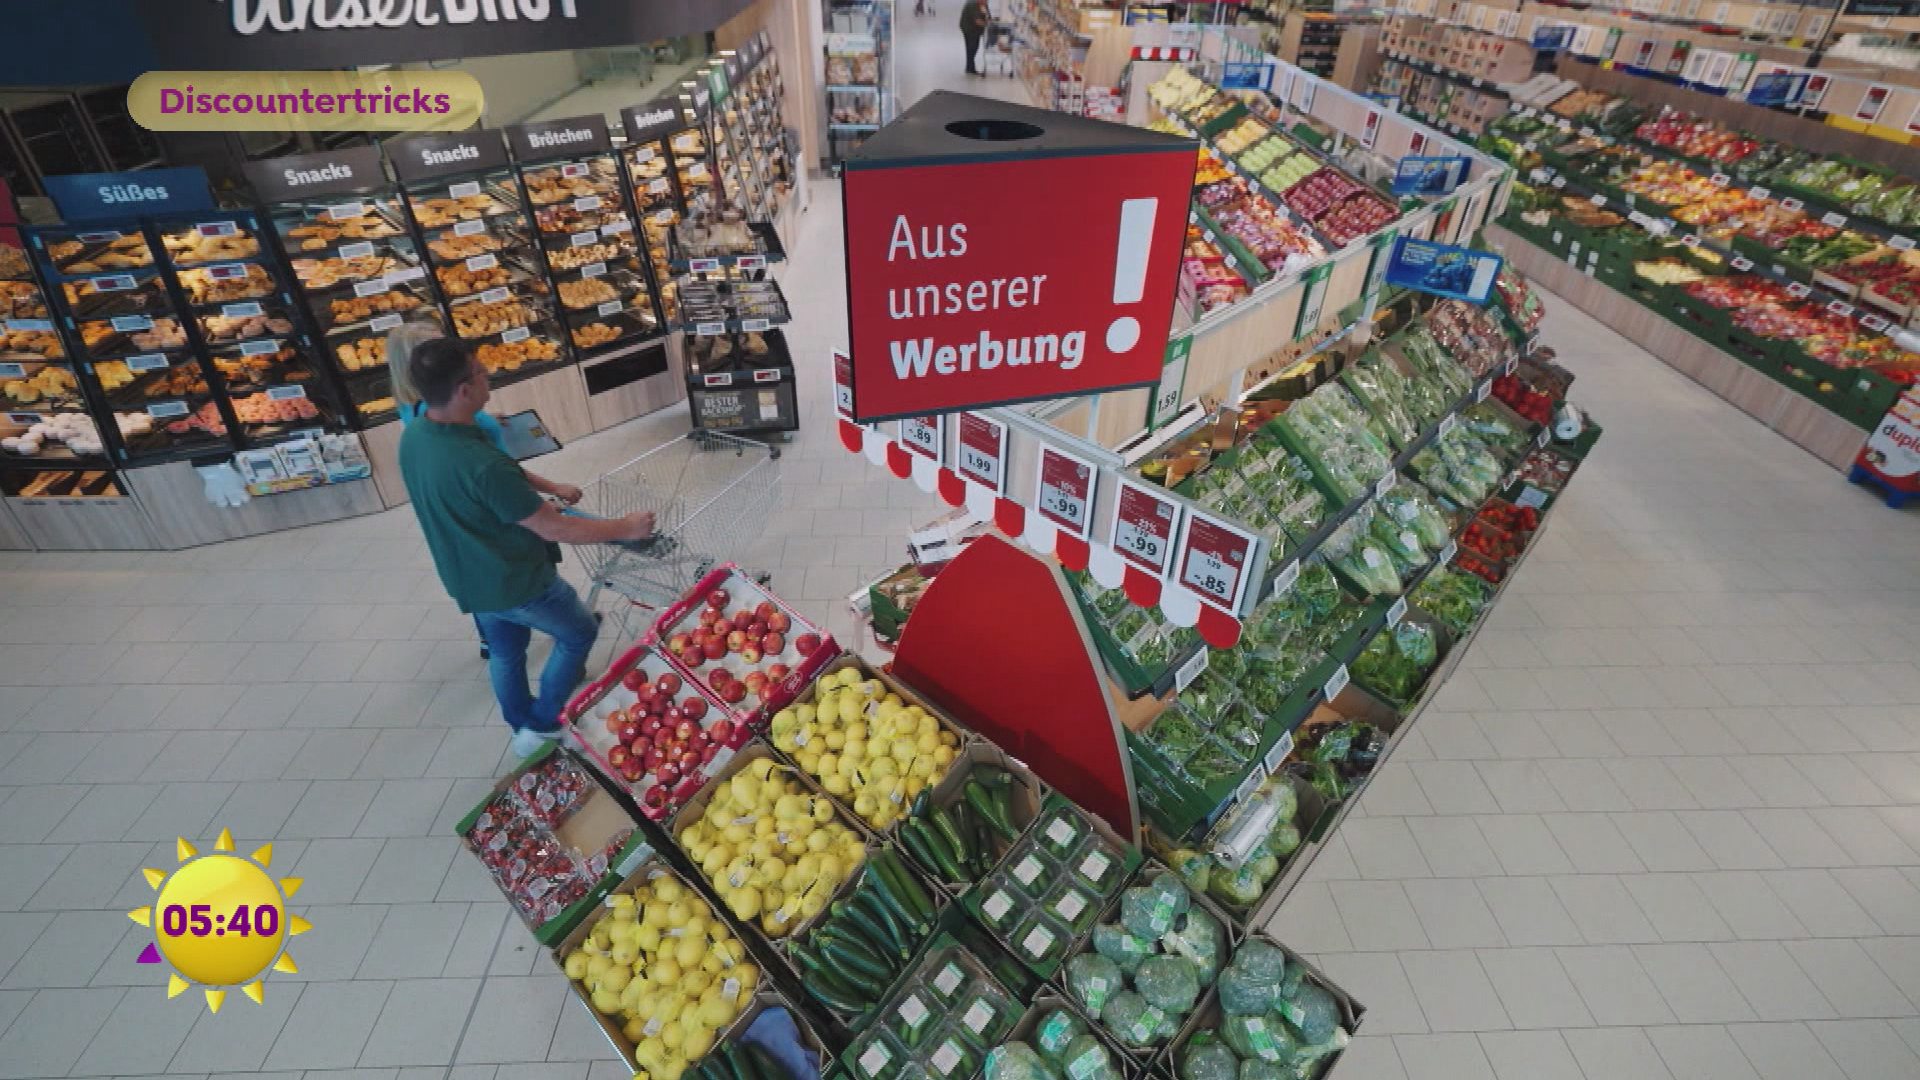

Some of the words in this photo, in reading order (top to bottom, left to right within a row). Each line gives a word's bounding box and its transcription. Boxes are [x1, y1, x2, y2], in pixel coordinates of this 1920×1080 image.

[528, 128, 593, 149] Brötchen
[422, 144, 480, 166] Snacks
[284, 163, 353, 186] Snacks
[98, 183, 169, 204] Süßes
[888, 214, 968, 262] Aus
[889, 274, 1047, 320] unserer
[890, 330, 1086, 380] Werbung
[1158, 390, 1177, 413] 1.59
[967, 452, 991, 473] 1.99
[1047, 498, 1078, 518] -.99
[1124, 536, 1157, 556] -.99
[1193, 574, 1226, 594] -.85
